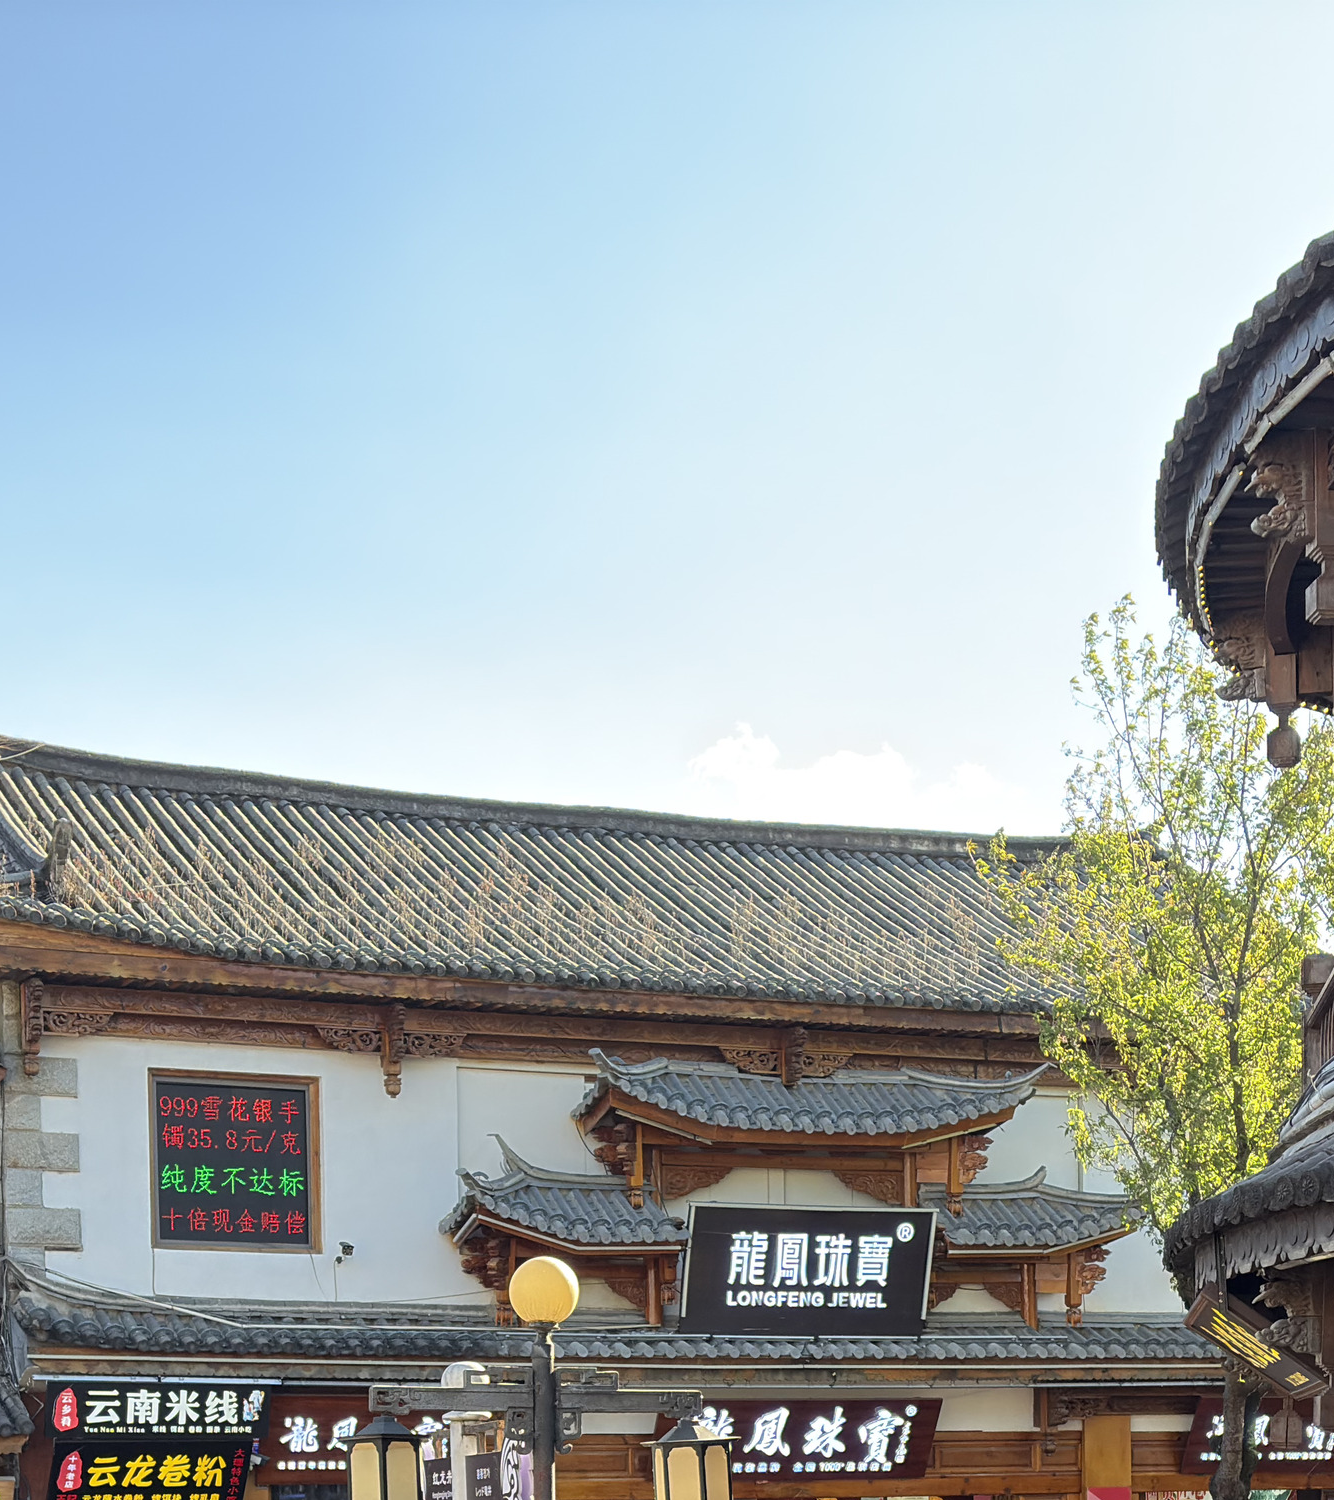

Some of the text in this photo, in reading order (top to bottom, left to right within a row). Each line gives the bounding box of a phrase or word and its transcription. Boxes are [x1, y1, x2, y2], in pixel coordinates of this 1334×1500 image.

[159, 1096, 300, 1124] 999雪花银手
[162, 1124, 301, 1154] 镯35.8元/克
[161, 1164, 304, 1197] 纯度不达标
[161, 1207, 306, 1235] 十倍现金赔偿
[727, 1231, 893, 1288] 龍鳳珠寶
[726, 1290, 887, 1308] LONGFENG JEWEL
[85, 1389, 239, 1425] 云南米线
[87, 1454, 227, 1488] 云龙卷粉
